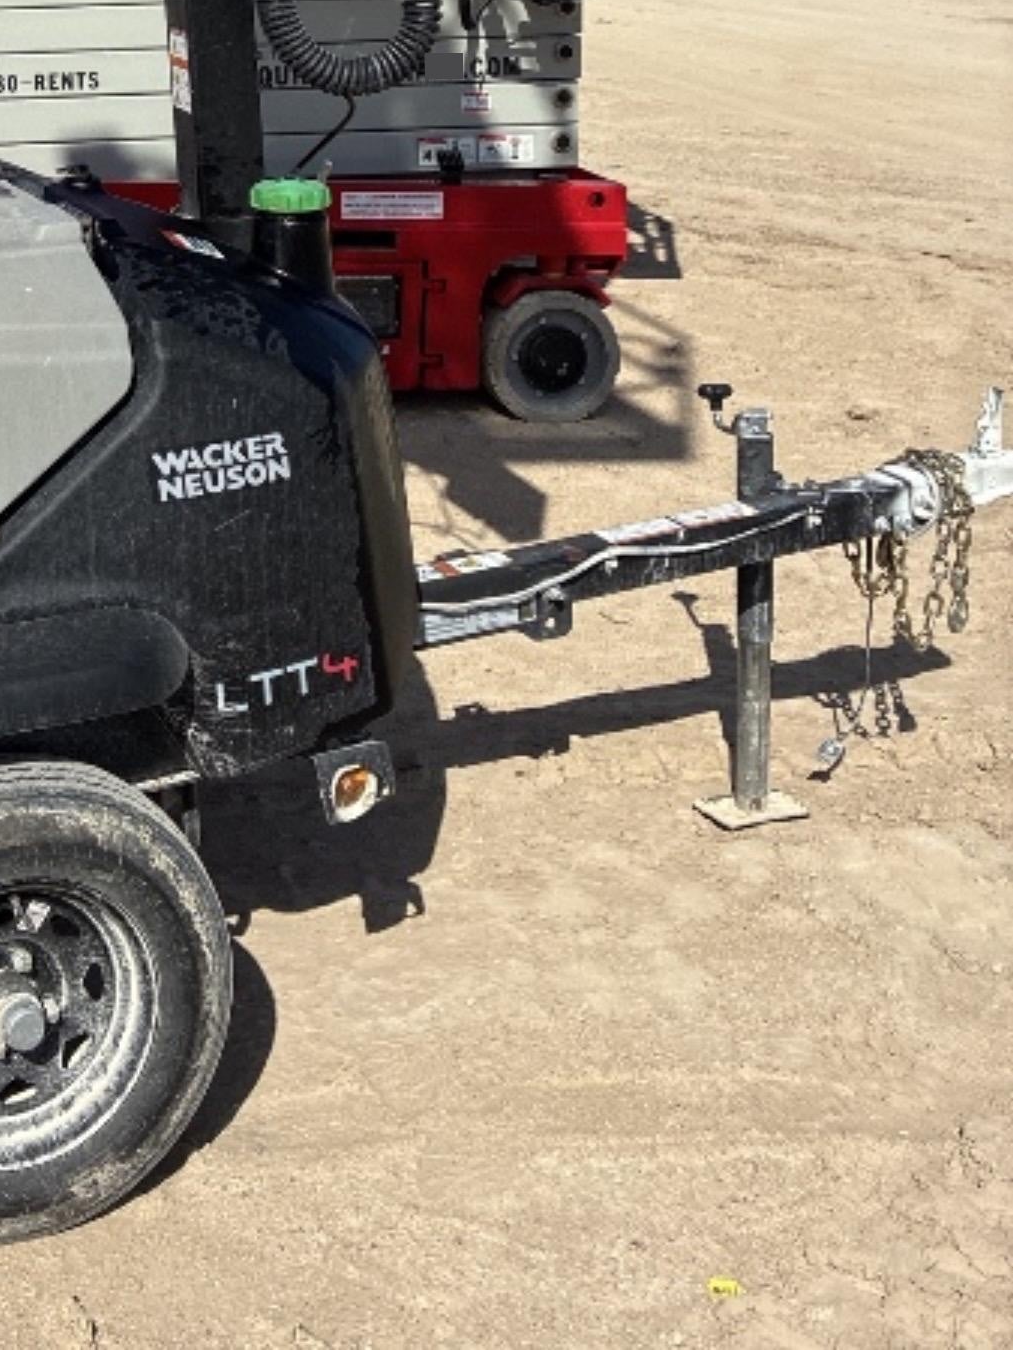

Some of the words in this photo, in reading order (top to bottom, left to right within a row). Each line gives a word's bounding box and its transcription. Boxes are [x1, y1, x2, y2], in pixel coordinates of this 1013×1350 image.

[151, 430, 289, 476] WACKER
[156, 454, 292, 503] NEUSON
[215, 652, 360, 713] LTT4
